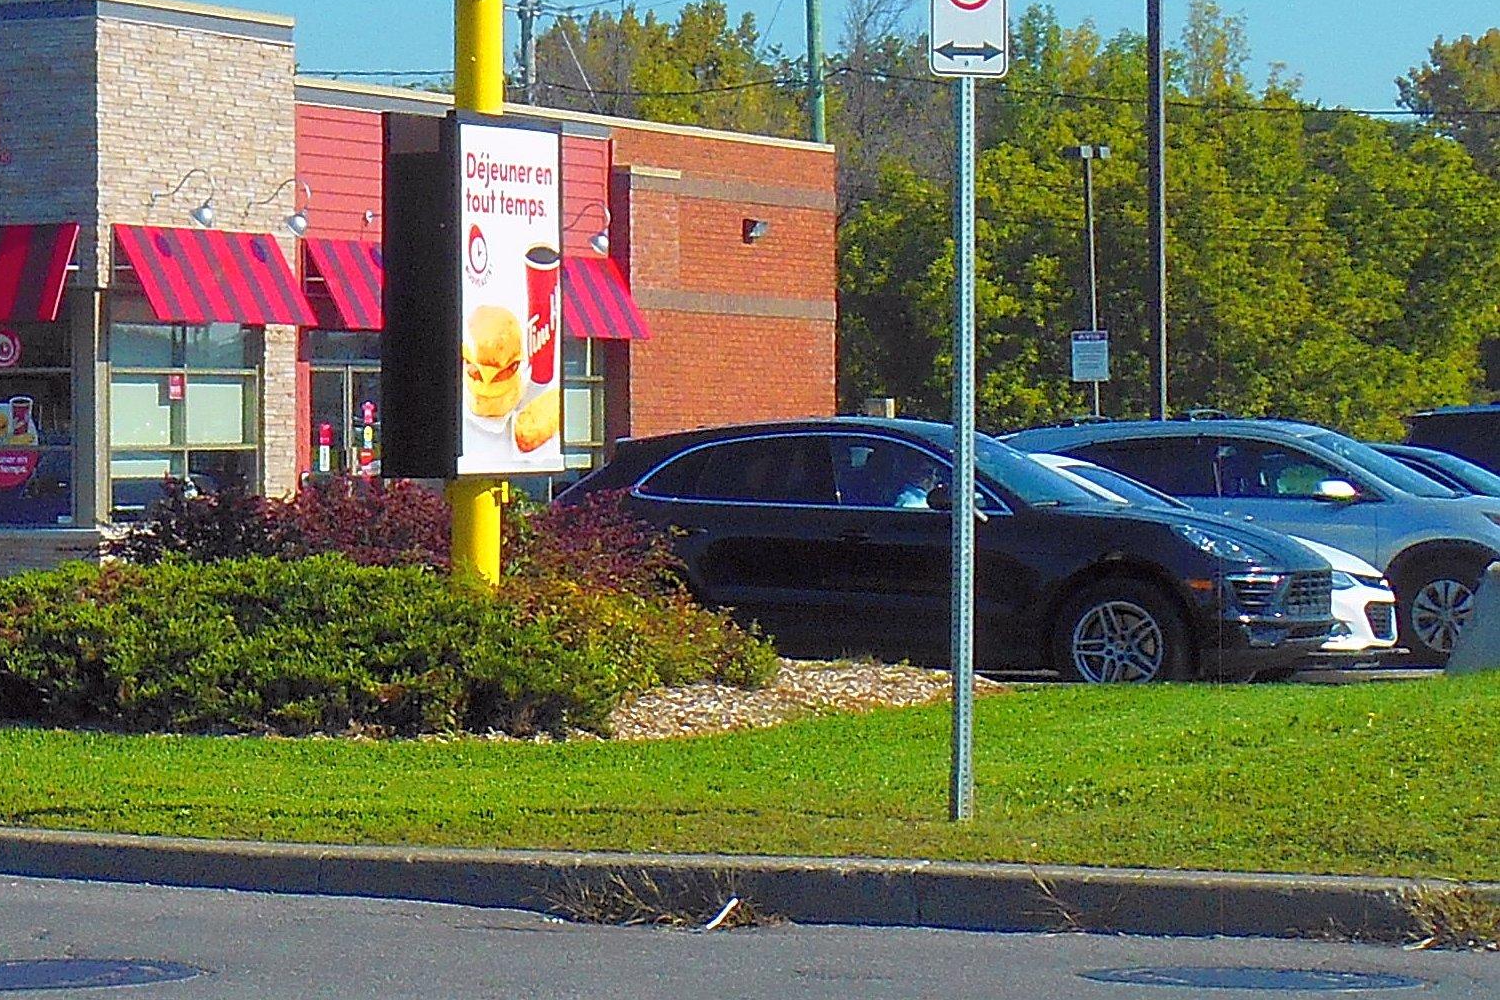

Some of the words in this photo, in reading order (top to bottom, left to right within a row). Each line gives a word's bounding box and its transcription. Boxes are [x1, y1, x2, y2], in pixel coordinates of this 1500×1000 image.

[466, 152, 532, 188] Déjeuner
[535, 167, 552, 185] en
[466, 187, 495, 213] tout
[500, 190, 547, 224] temps.
[527, 313, 550, 358] Tim
